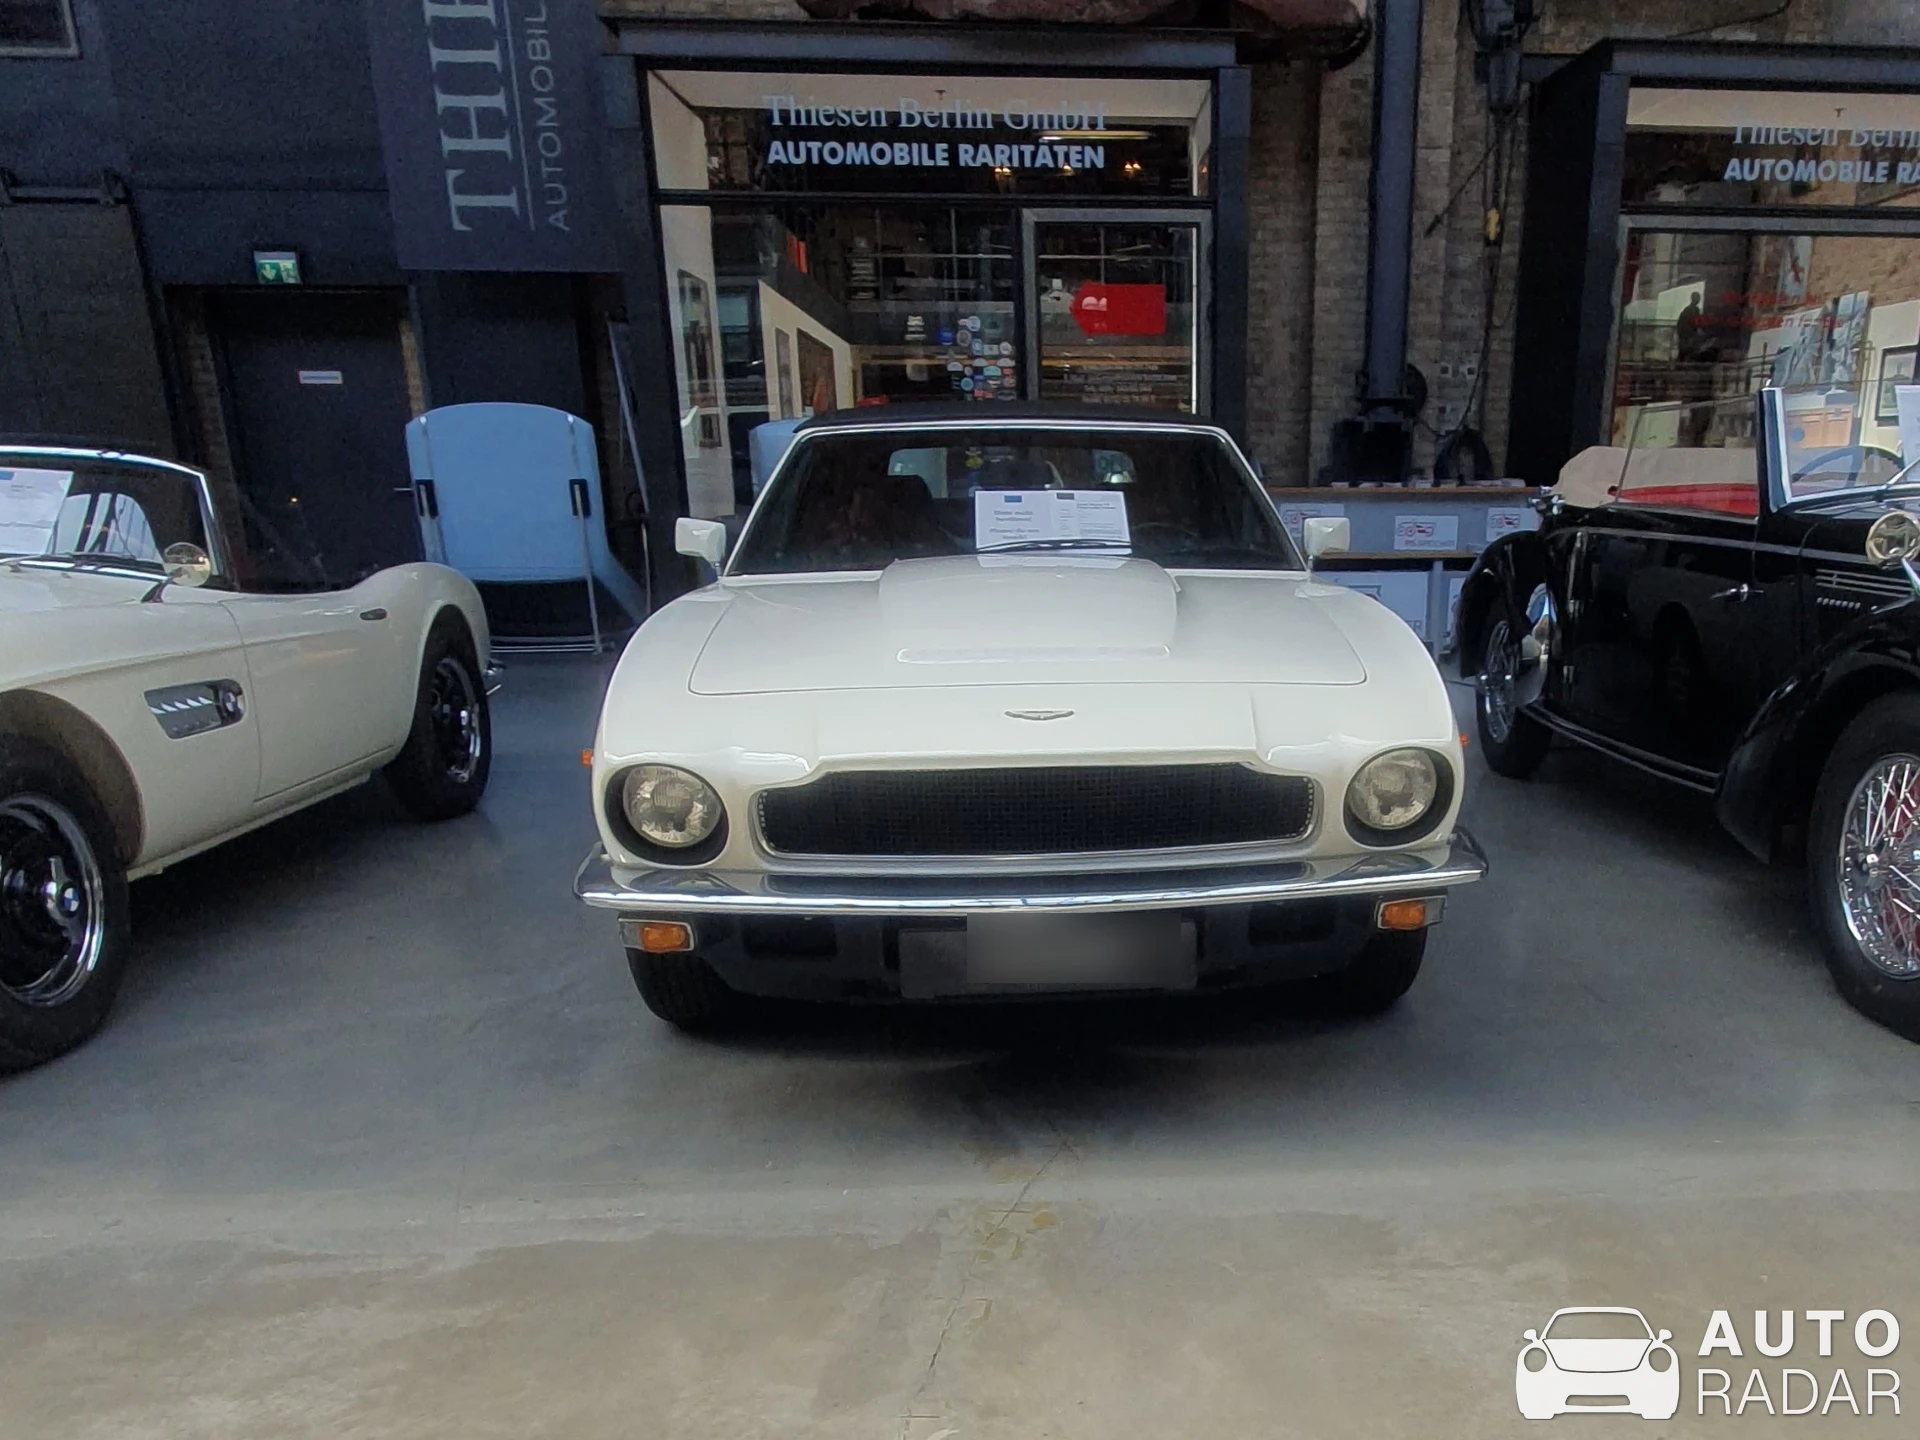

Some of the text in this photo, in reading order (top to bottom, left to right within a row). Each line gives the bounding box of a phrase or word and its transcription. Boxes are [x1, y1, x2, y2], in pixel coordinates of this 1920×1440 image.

[762, 95, 1106, 132] Thiesen Berlin GmbH
[768, 140, 1105, 169] AUTOMOBILE RARITÄTEN
[1723, 157, 1890, 184] AUTOMOBILE
